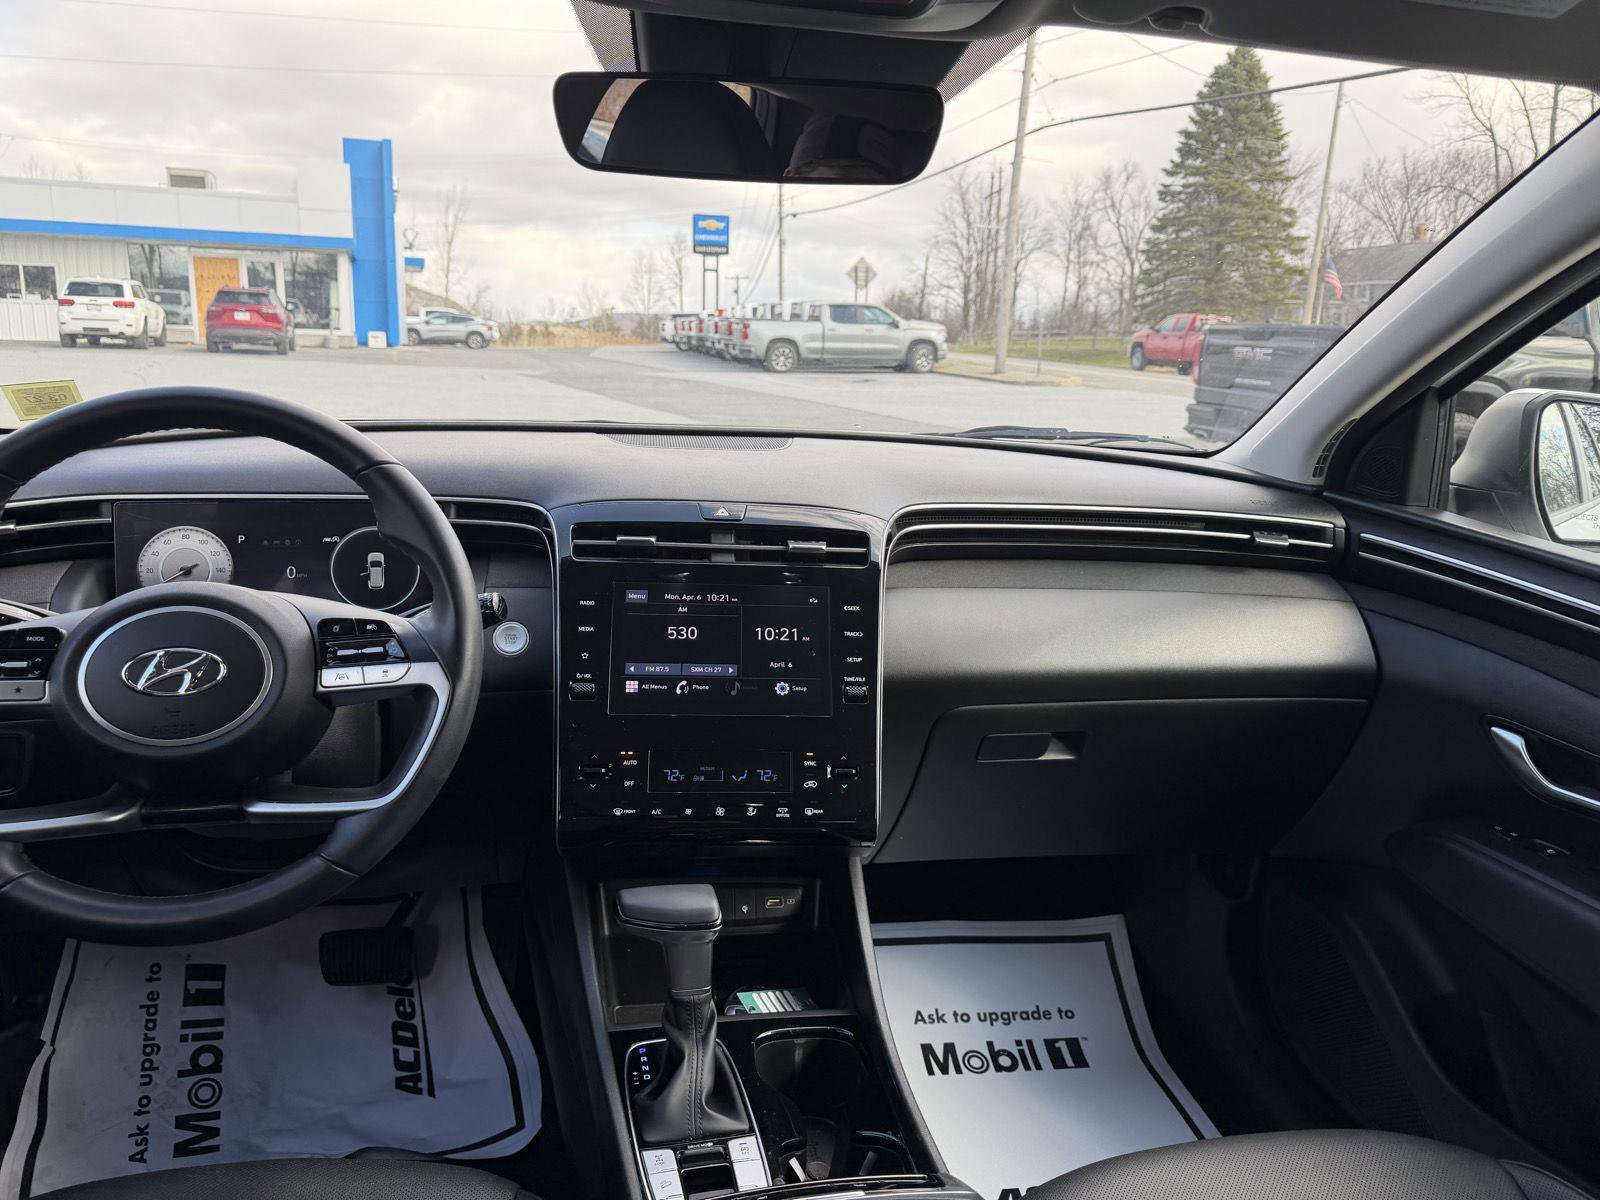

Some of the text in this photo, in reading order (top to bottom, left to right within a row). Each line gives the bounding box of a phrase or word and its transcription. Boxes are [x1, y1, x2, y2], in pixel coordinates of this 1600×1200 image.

[238, 535, 245, 544] P
[286, 566, 296, 579] 0
[667, 626, 698, 640] 530
[755, 627, 798, 641] 10:21
[914, 1005, 1076, 1026] Ask to upgrade to
[128, 962, 162, 1164] Ask to upgrade to
[920, 1038, 1044, 1076] Mobil
[172, 1017, 225, 1158] Mobil
